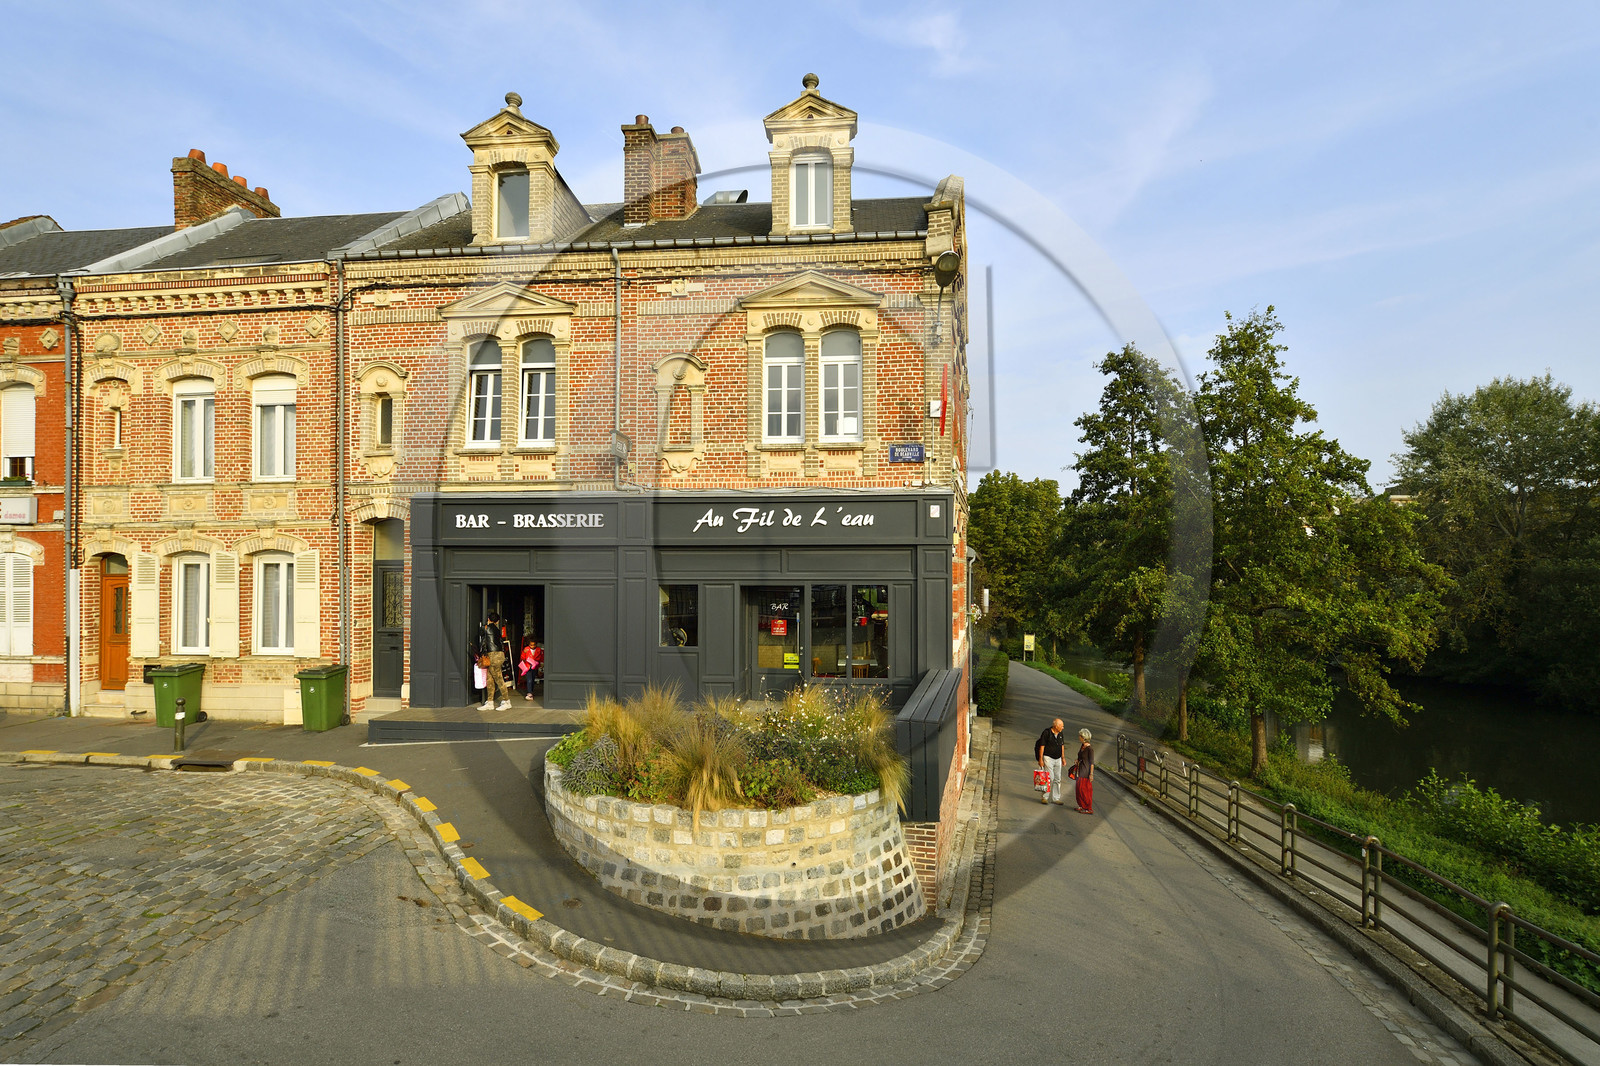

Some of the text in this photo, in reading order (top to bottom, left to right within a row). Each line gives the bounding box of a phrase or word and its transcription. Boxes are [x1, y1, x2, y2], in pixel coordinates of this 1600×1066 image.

[455, 514, 490, 528] BAR
[513, 513, 605, 528] BRASSERIE
[692, 508, 724, 532] Au
[732, 507, 775, 533] Fil
[782, 508, 802, 526] de
[770, 602, 789, 611] BAR
